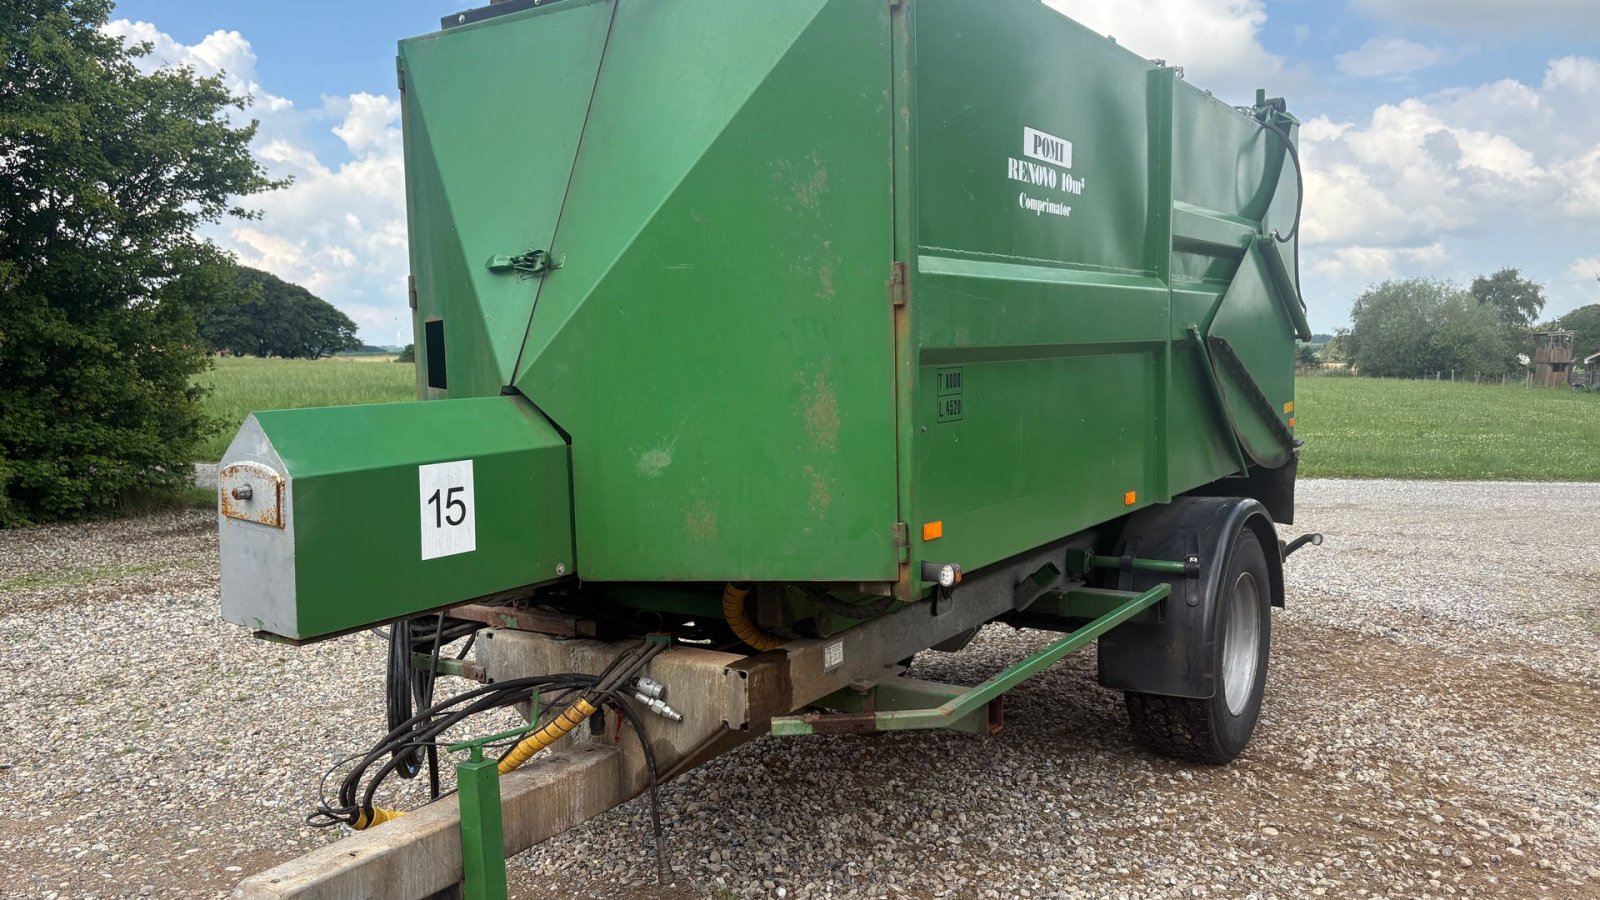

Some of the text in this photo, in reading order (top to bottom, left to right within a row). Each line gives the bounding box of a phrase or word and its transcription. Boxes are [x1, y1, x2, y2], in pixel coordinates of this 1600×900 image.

[1033, 133, 1064, 163] POMI
[1007, 157, 1057, 189] RENOVO
[1019, 192, 1072, 217] Comprimator
[938, 373, 943, 390] T
[939, 399, 961, 417] L 4520
[428, 486, 467, 529] 15
